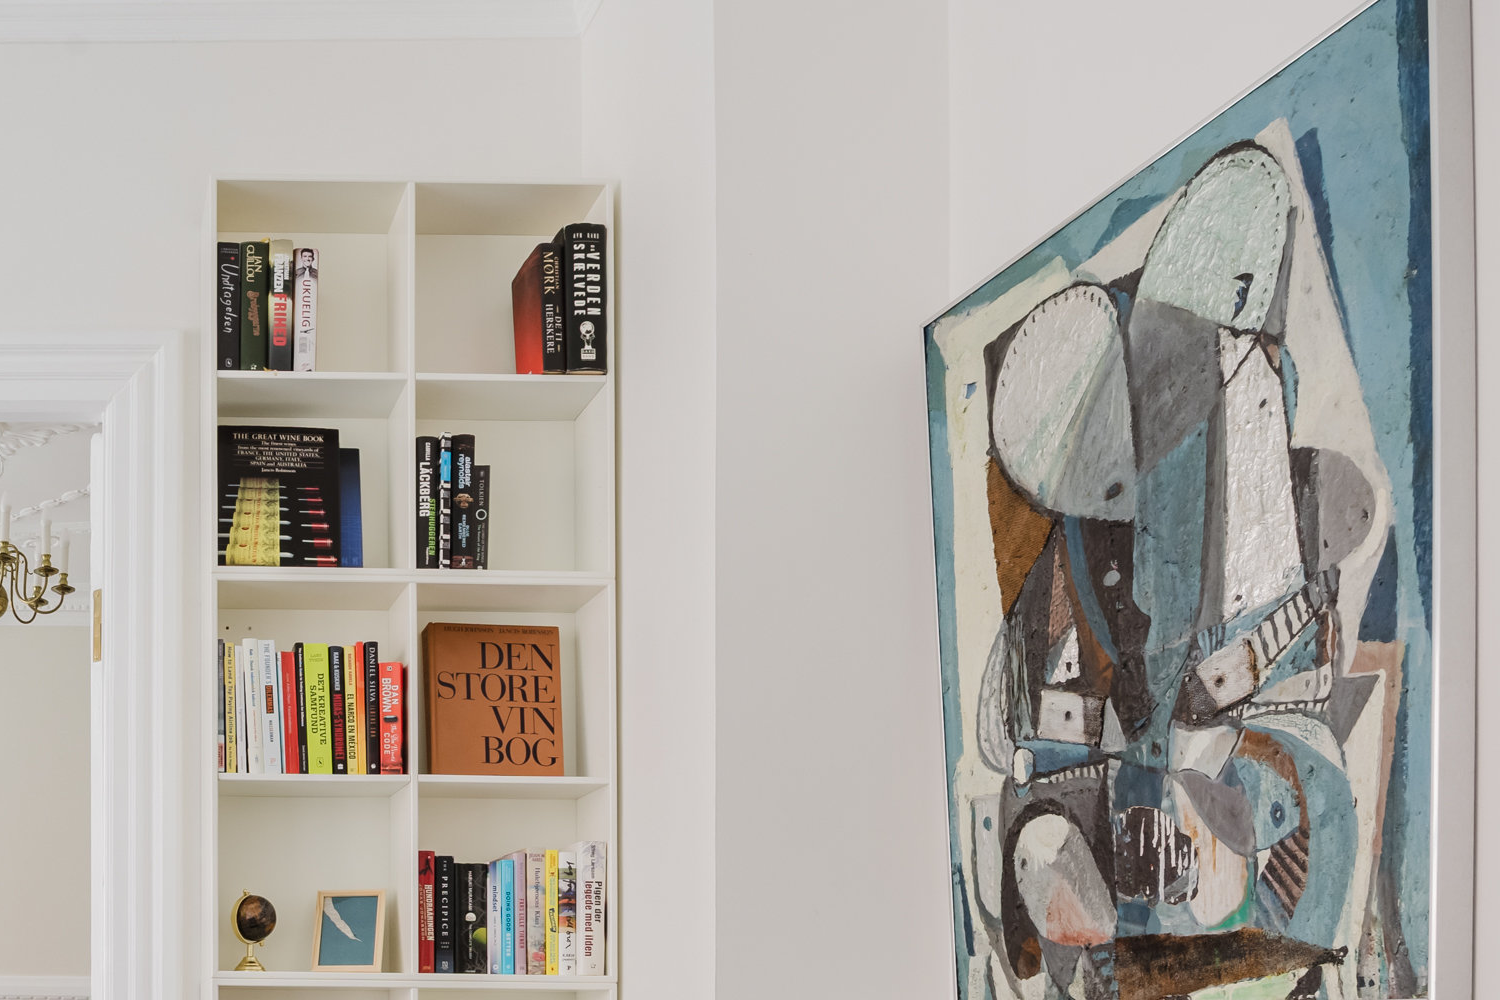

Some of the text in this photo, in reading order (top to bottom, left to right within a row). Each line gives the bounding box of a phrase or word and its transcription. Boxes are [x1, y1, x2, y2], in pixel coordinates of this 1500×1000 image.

[246, 244, 256, 282] GUILLOU
[254, 256, 263, 273] JAN
[273, 254, 284, 293] FRANZEN
[543, 251, 555, 295] MØRK
[573, 243, 585, 316] SKÆLVEDE
[586, 252, 601, 316] VERDEN
[219, 263, 239, 333] Undtagelsen
[301, 279, 311, 327] UKUELIG
[272, 293, 288, 347] FRIHED
[545, 303, 554, 354] HERSKERE
[555, 316, 563, 341] DE TI
[233, 432, 249, 440] THE
[303, 435, 324, 443] BOOK
[419, 461, 432, 517] LÄCKBERG
[457, 453, 466, 489] reynolds
[428, 498, 436, 556] STENHUGGEREN
[264, 654, 272, 685] FOUNDER'S
[477, 641, 556, 671] DEN
[382, 677, 392, 713] BROWN
[437, 671, 556, 703] STORE
[310, 685, 318, 734] SAMFUND
[318, 696, 327, 745] KREATIVE
[333, 694, 345, 760] MIDAS-SYNDROMET
[348, 725, 355, 734] EN
[488, 705, 557, 735] VIN
[348, 736, 357, 760] MÉXICO
[481, 736, 560, 767] BOG
[424, 884, 434, 941] HUNDRAÅRINGEN
[584, 880, 594, 957] legede med ilden
[594, 880, 602, 923] Pigen der
